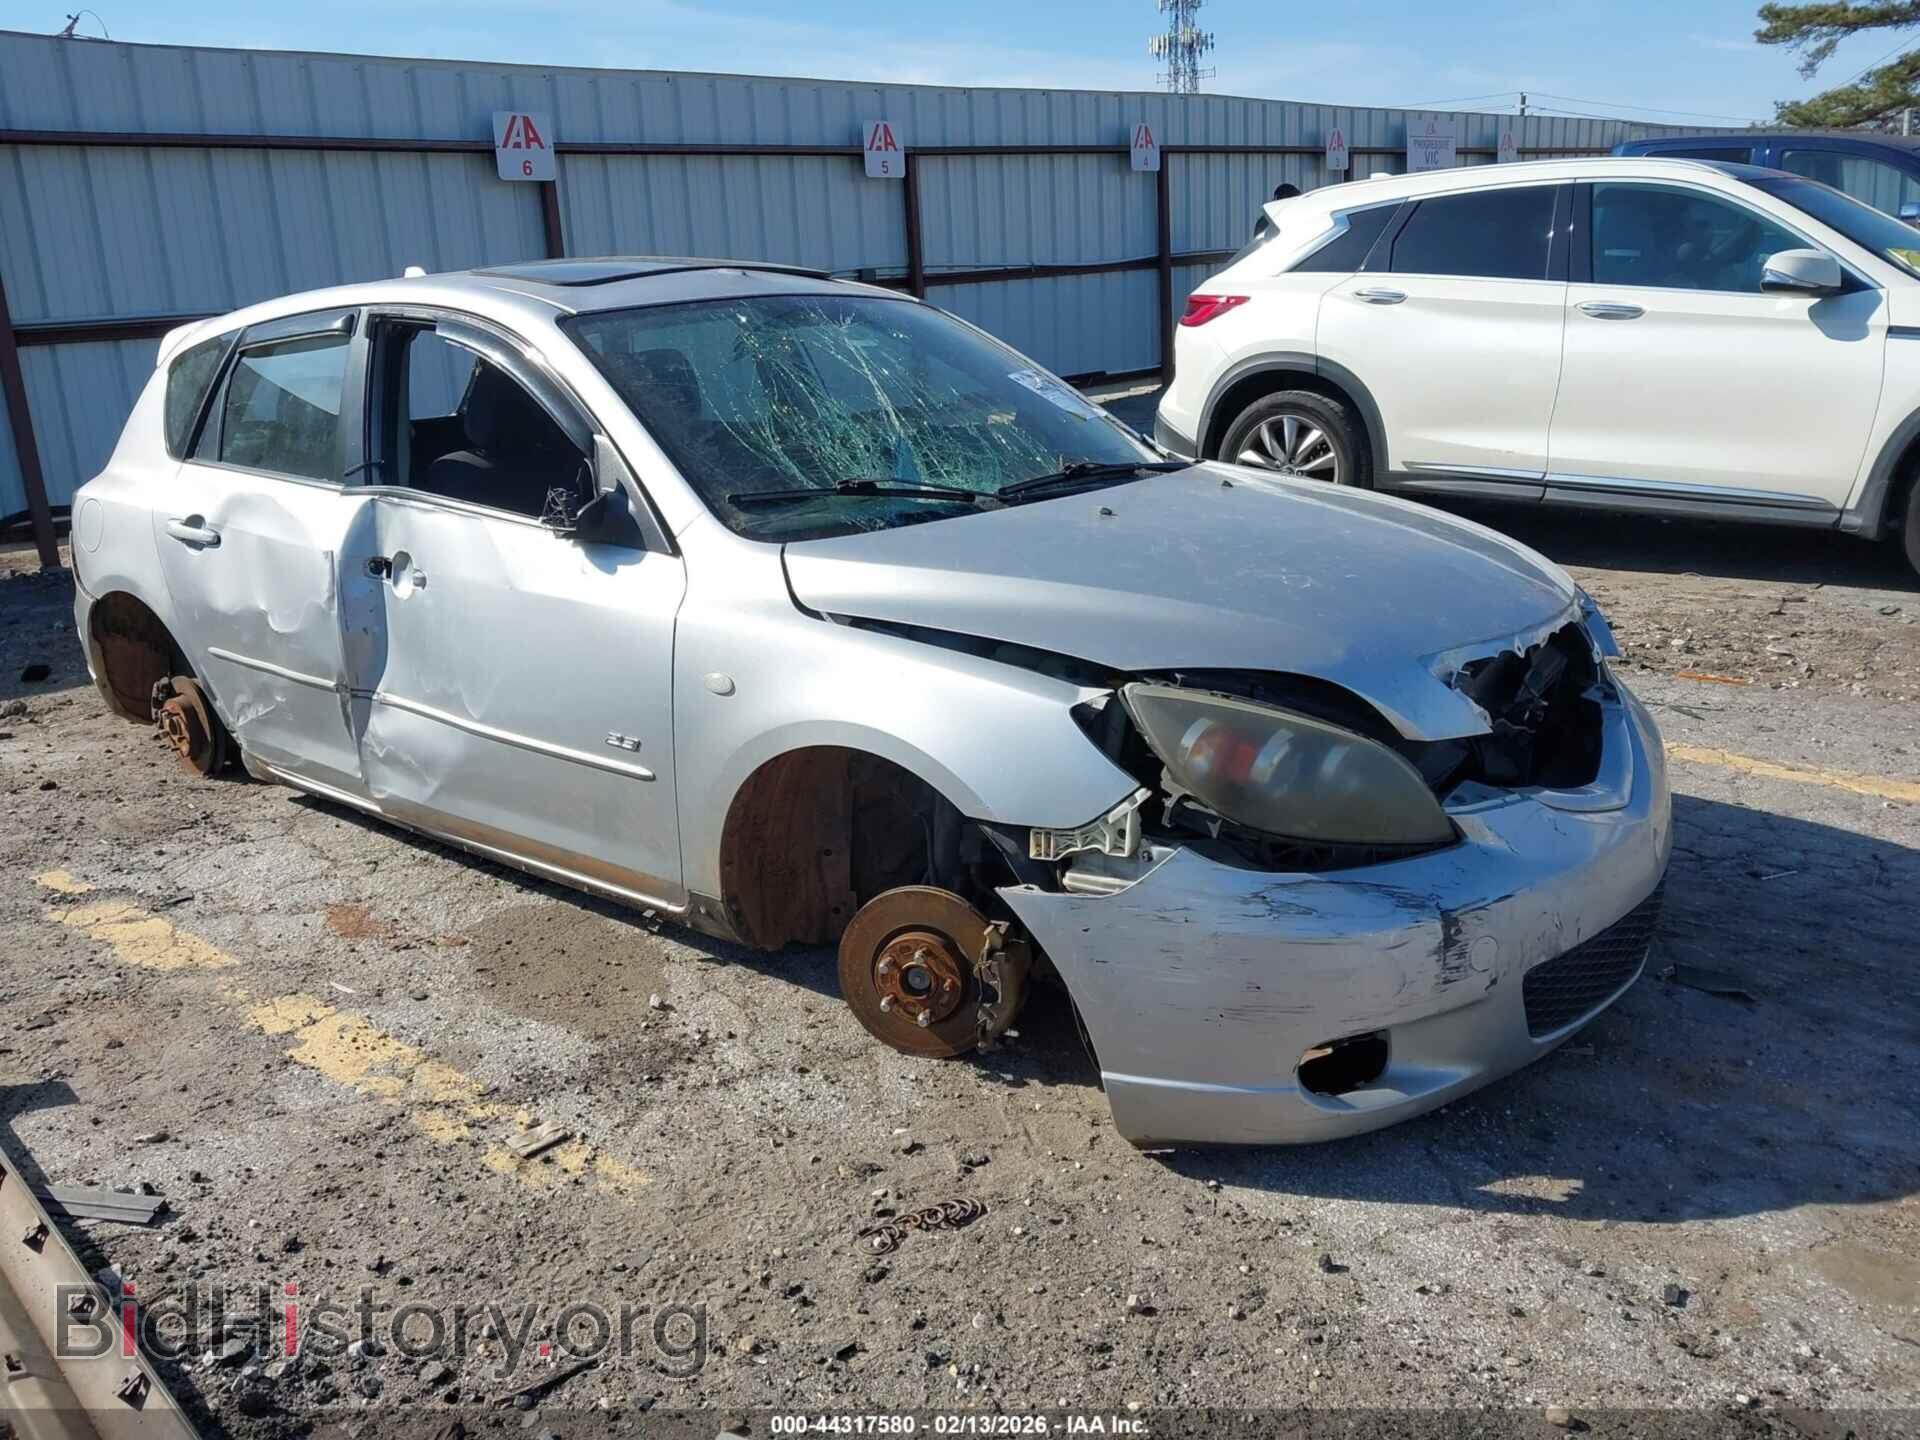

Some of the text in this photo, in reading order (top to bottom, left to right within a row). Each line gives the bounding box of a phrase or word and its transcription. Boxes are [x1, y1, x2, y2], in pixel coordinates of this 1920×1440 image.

[1143, 155, 1150, 168] 4
[1424, 151, 1440, 166] VIC
[523, 160, 533, 176] 6
[882, 160, 889, 174] 5
